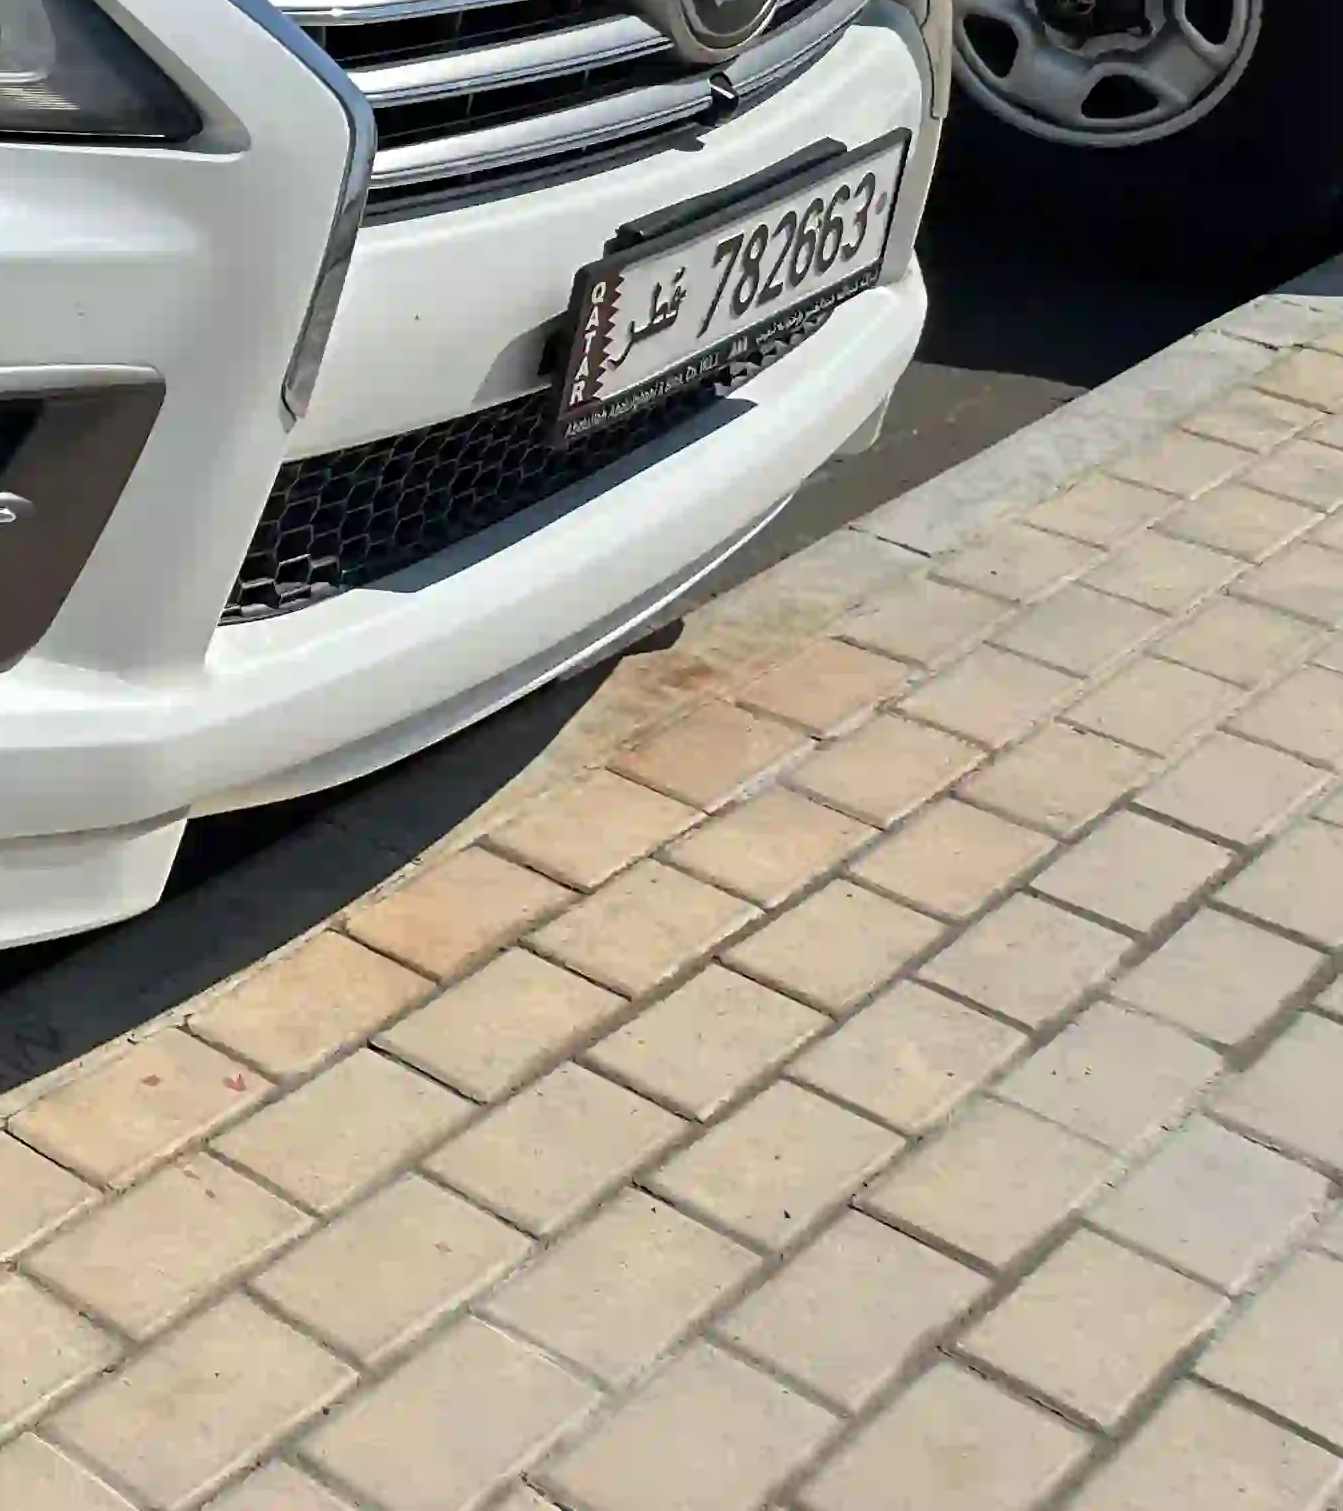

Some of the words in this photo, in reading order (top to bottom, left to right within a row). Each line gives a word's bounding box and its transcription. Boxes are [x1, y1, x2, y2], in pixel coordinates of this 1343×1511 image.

[608, 265, 688, 366] قطر
[696, 172, 876, 339] 782663
[569, 280, 607, 406] QATAR
